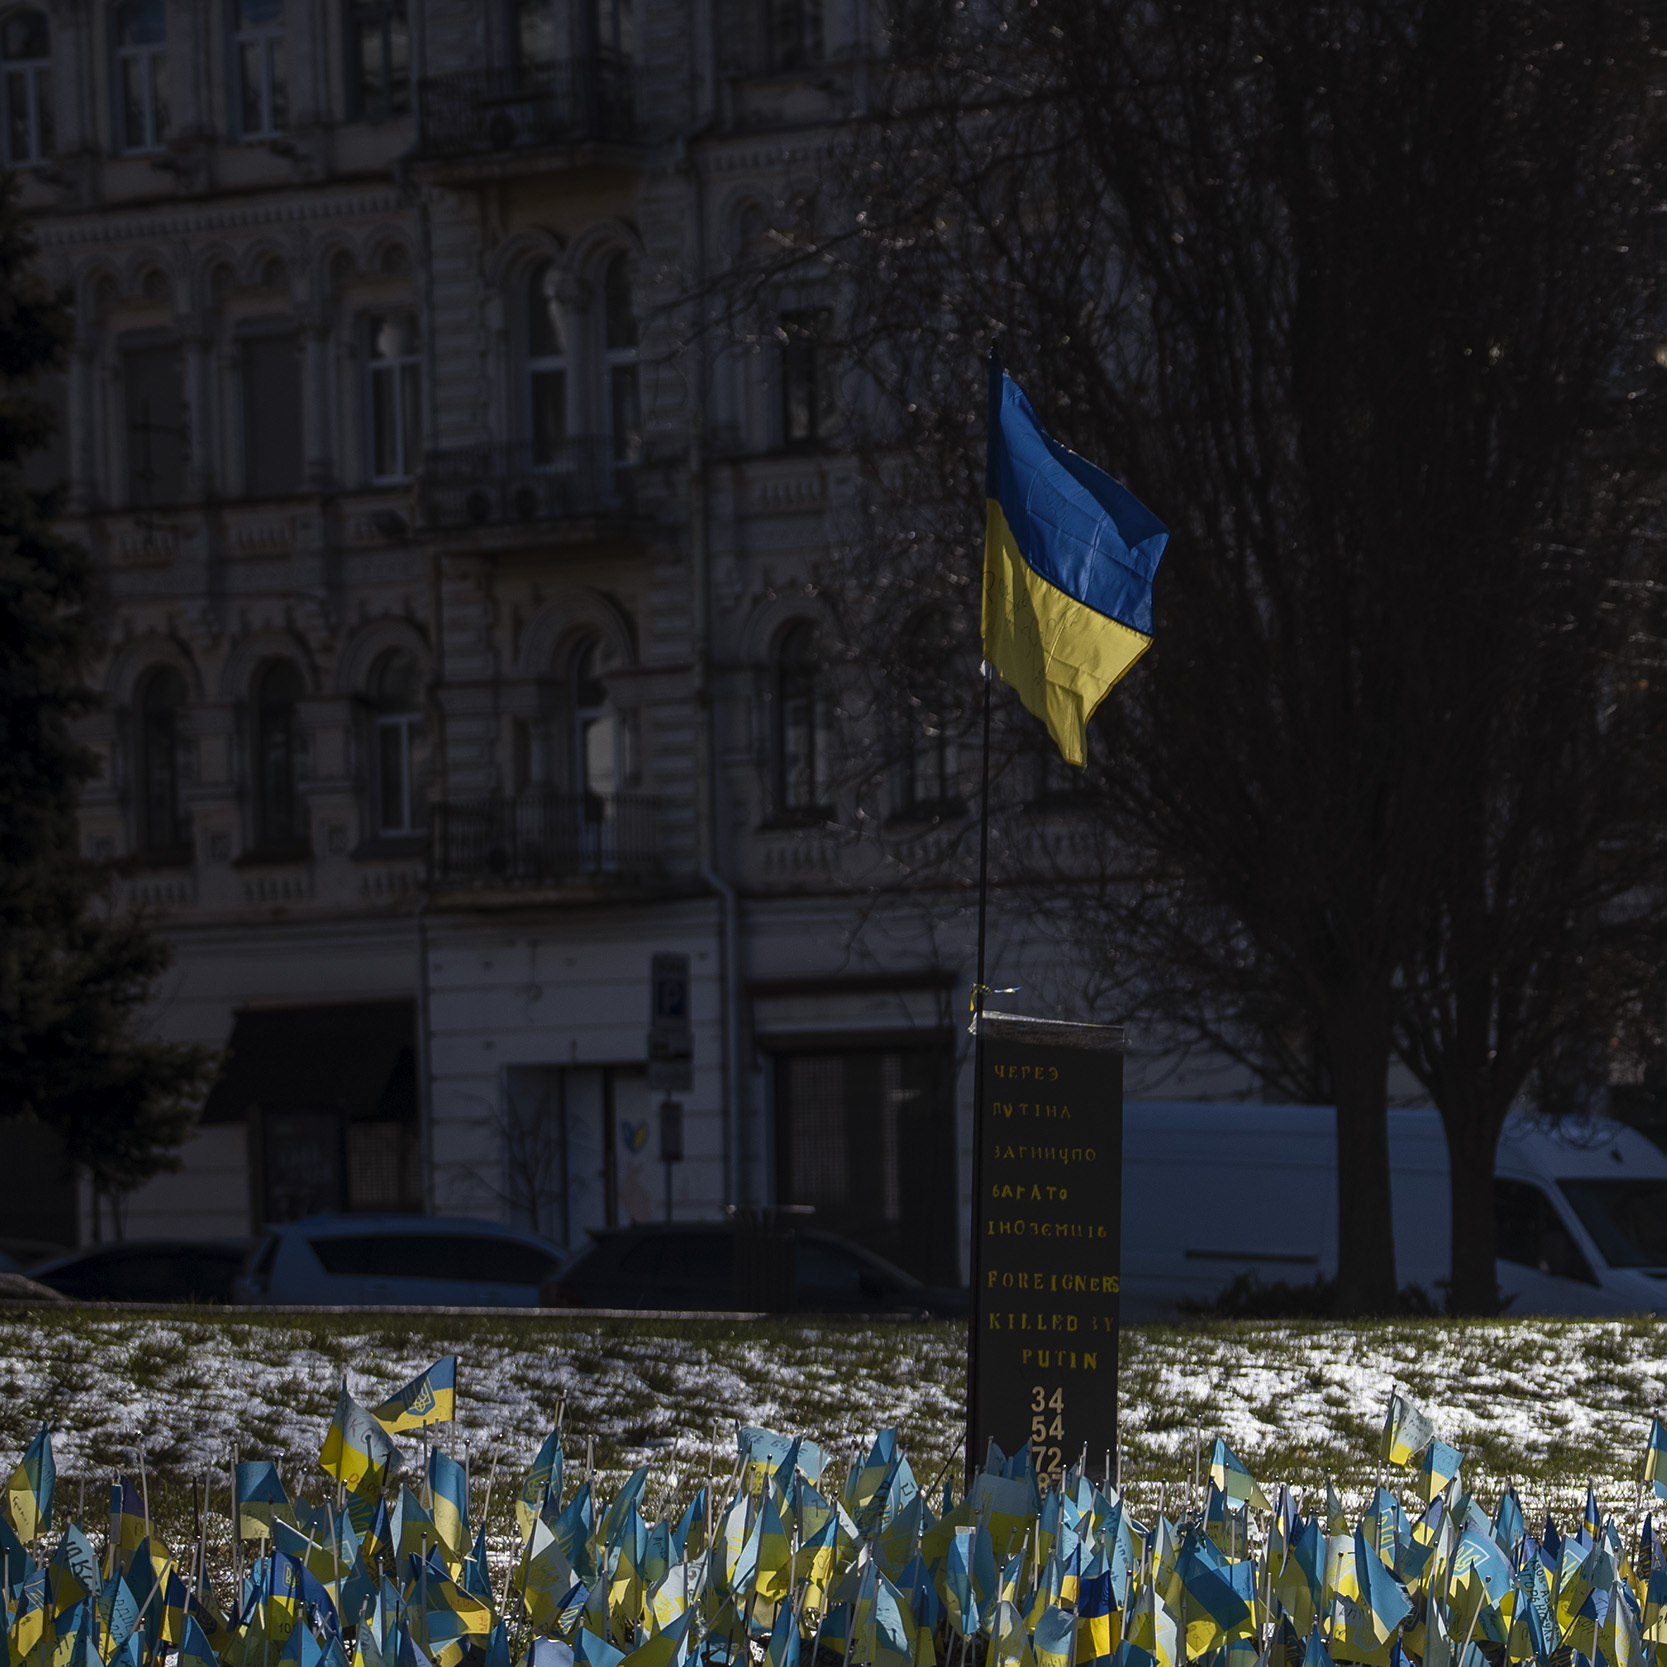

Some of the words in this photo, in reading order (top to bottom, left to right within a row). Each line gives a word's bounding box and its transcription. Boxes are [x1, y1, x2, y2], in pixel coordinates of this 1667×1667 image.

[987, 1269, 1120, 1294] FOREIGNERS
[989, 1313, 1078, 1332] KILLED
[1091, 1316, 1116, 1333] BY
[1021, 1348, 1097, 1369] PUTIN
[1030, 1386, 1064, 1413] 34
[1031, 1415, 1064, 1441] 54
[1032, 1446, 1062, 1473] 72
